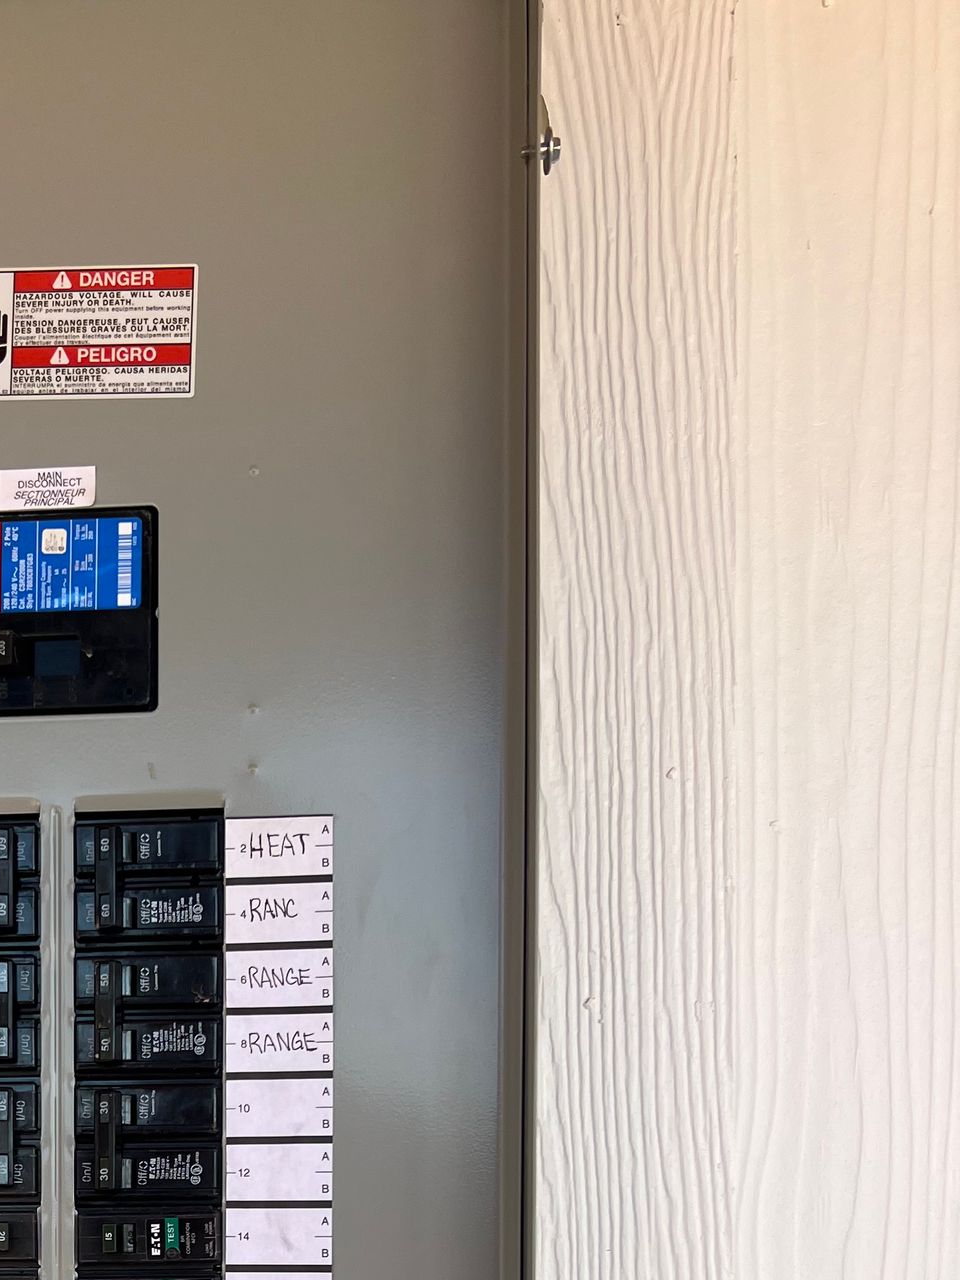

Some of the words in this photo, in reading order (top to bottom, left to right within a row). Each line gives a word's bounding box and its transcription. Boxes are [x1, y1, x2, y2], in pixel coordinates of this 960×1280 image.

[79, 270, 155, 287] DANGER
[16, 300, 49, 308] SEVERE
[77, 346, 157, 363] PELIGRO
[37, 472, 62, 481] MAIN
[18, 478, 82, 489] DISCONNECT
[14, 488, 86, 500] SECTIONNEUR
[24, 497, 75, 507] PRINCIPAL
[101, 838, 109, 852] 60
[240, 844, 247, 853] 2
[249, 833, 310, 859] HEAT
[240, 910, 246, 918] 4
[101, 974, 108, 987] 50
[240, 976, 247, 984] 6
[248, 966, 313, 989] RANGE
[101, 1039, 109, 1051] 50
[240, 1040, 247, 1048] 8
[248, 1030, 318, 1054] RANGE
[100, 1101, 108, 1114] 30
[239, 1104, 250, 1112] 10
[100, 1168, 108, 1181] 30
[239, 1168, 250, 1177] 12
[105, 1232, 112, 1241] 15
